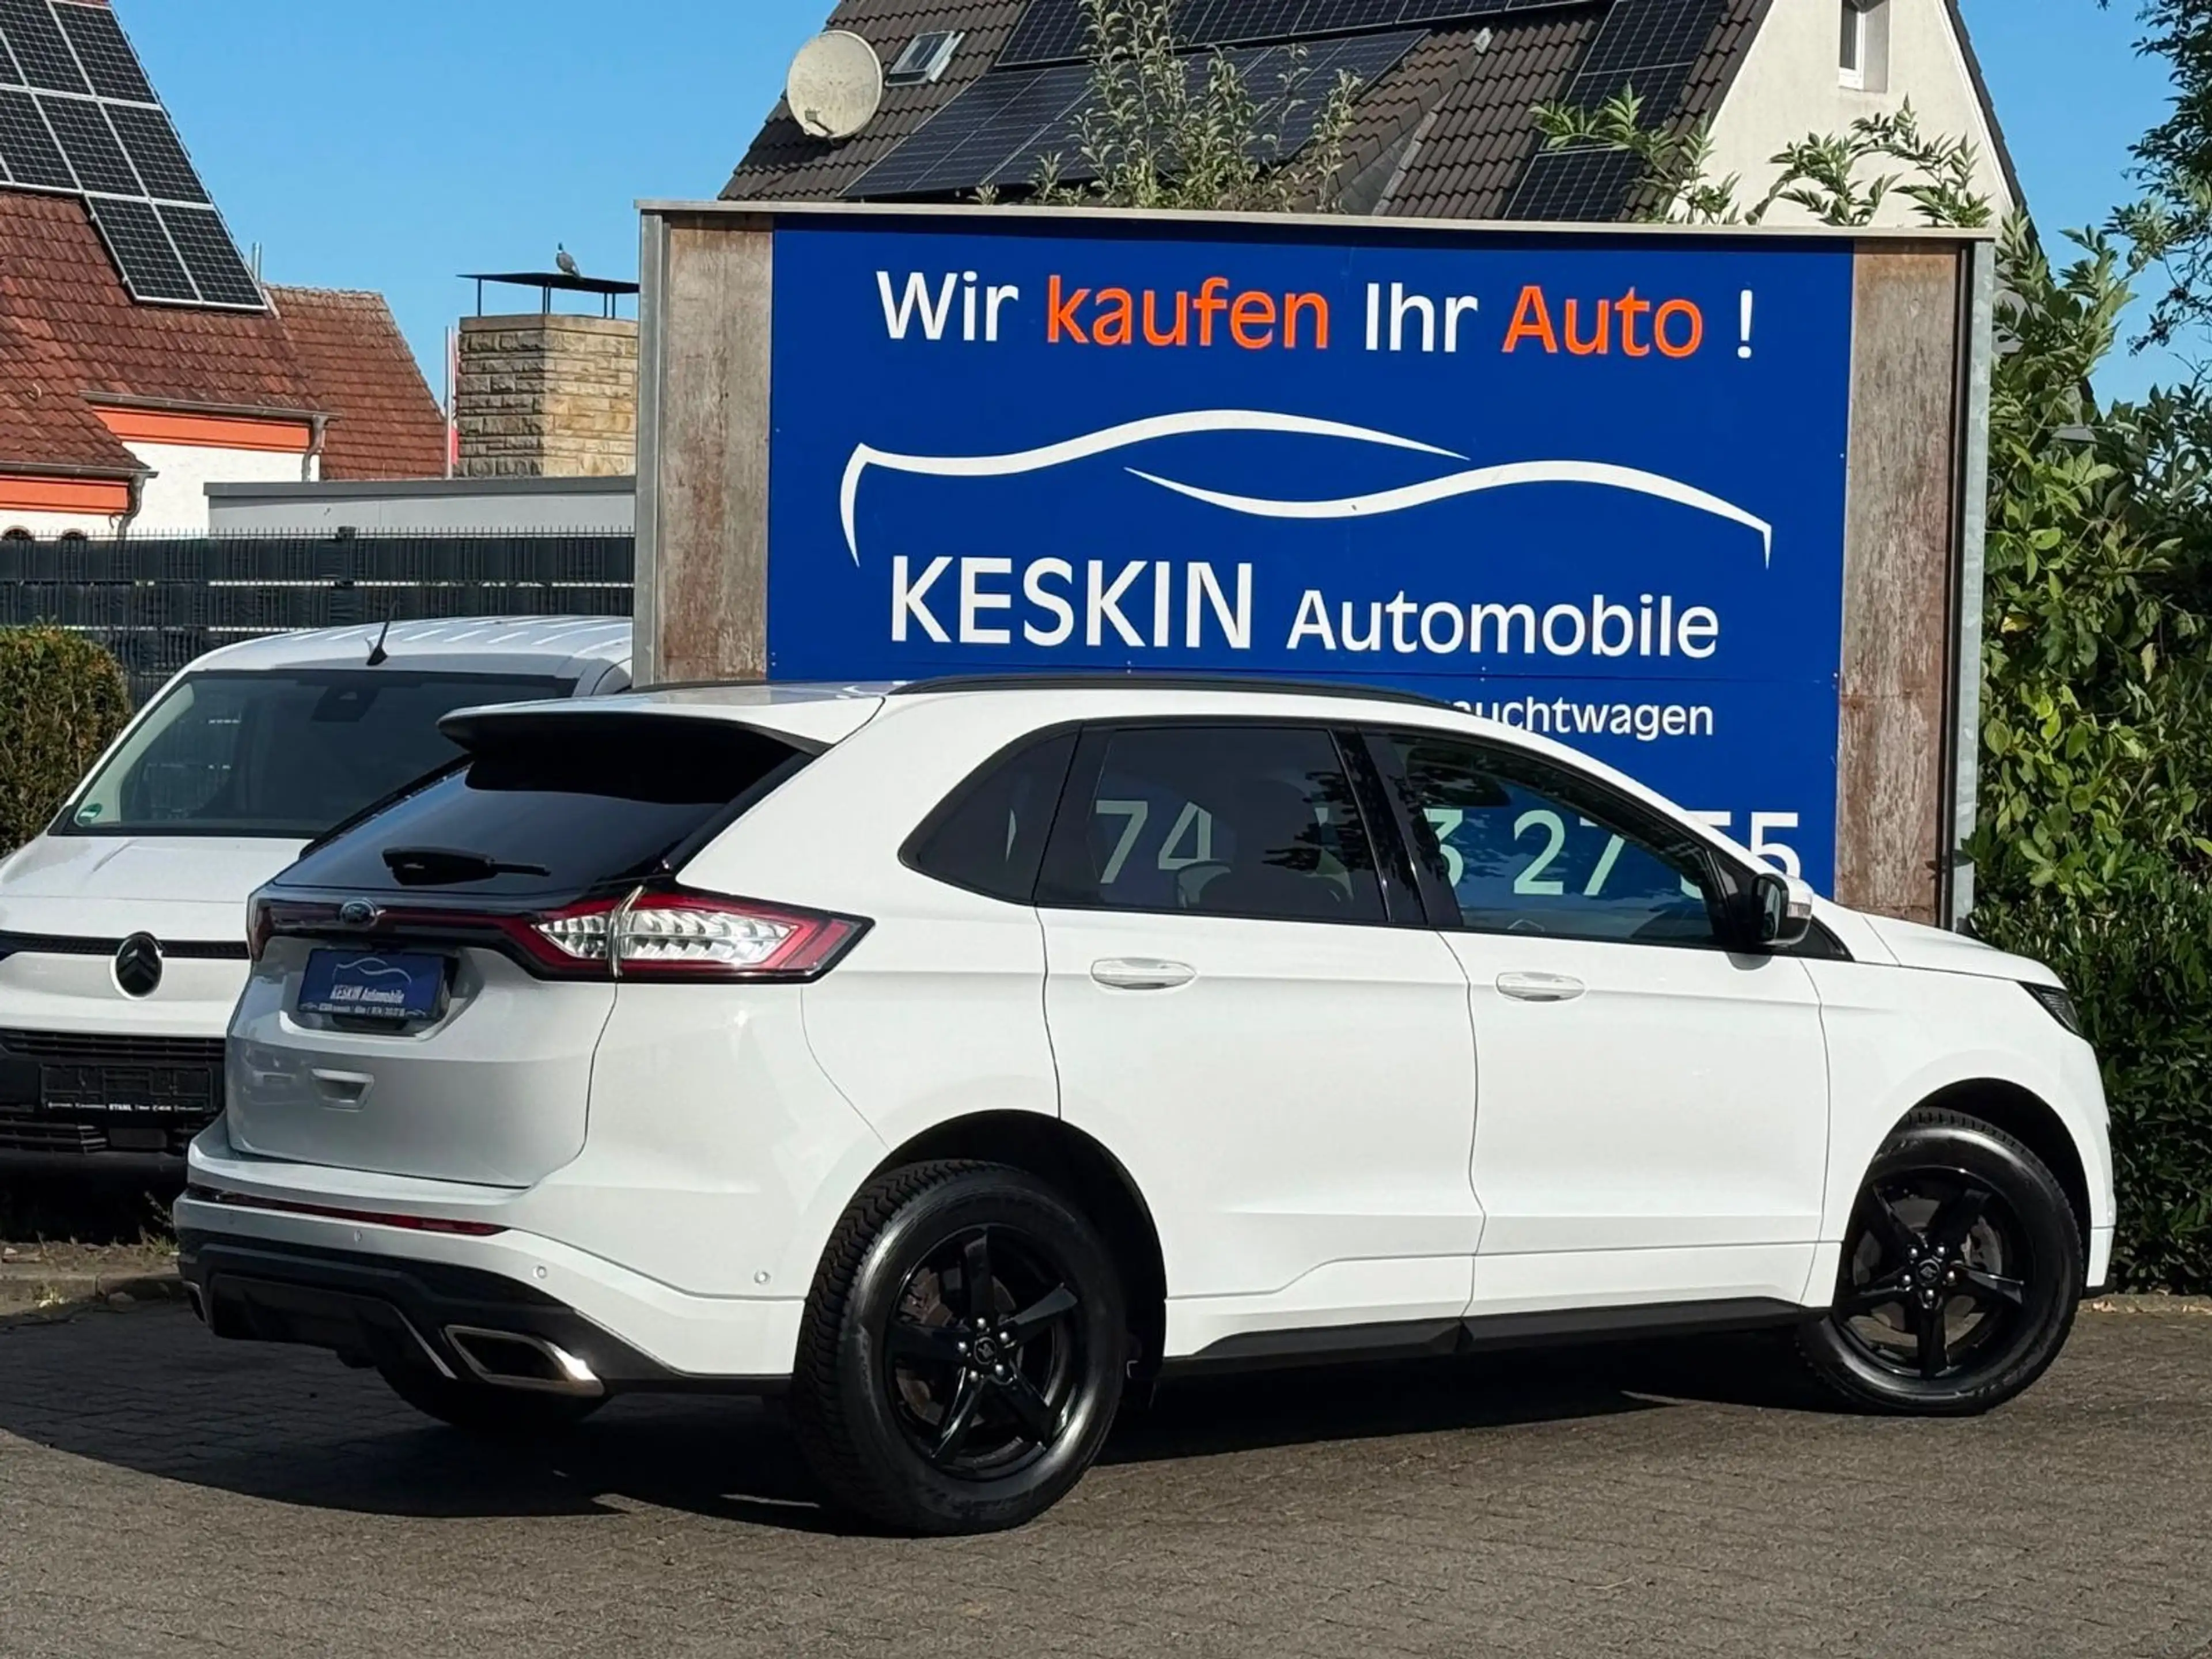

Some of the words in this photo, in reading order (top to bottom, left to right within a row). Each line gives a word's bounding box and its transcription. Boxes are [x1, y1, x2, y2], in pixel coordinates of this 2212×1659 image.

[876, 271, 1018, 341] Wir
[1047, 275, 1329, 350] kaufen
[1365, 282, 1478, 352] Ihr
[1502, 285, 1703, 358] Auto
[1737, 290, 1753, 359] !
[891, 555, 1252, 649] KESKIN
[1286, 589, 1719, 659] Automobile
[1453, 696, 1713, 742] uchtwagen
